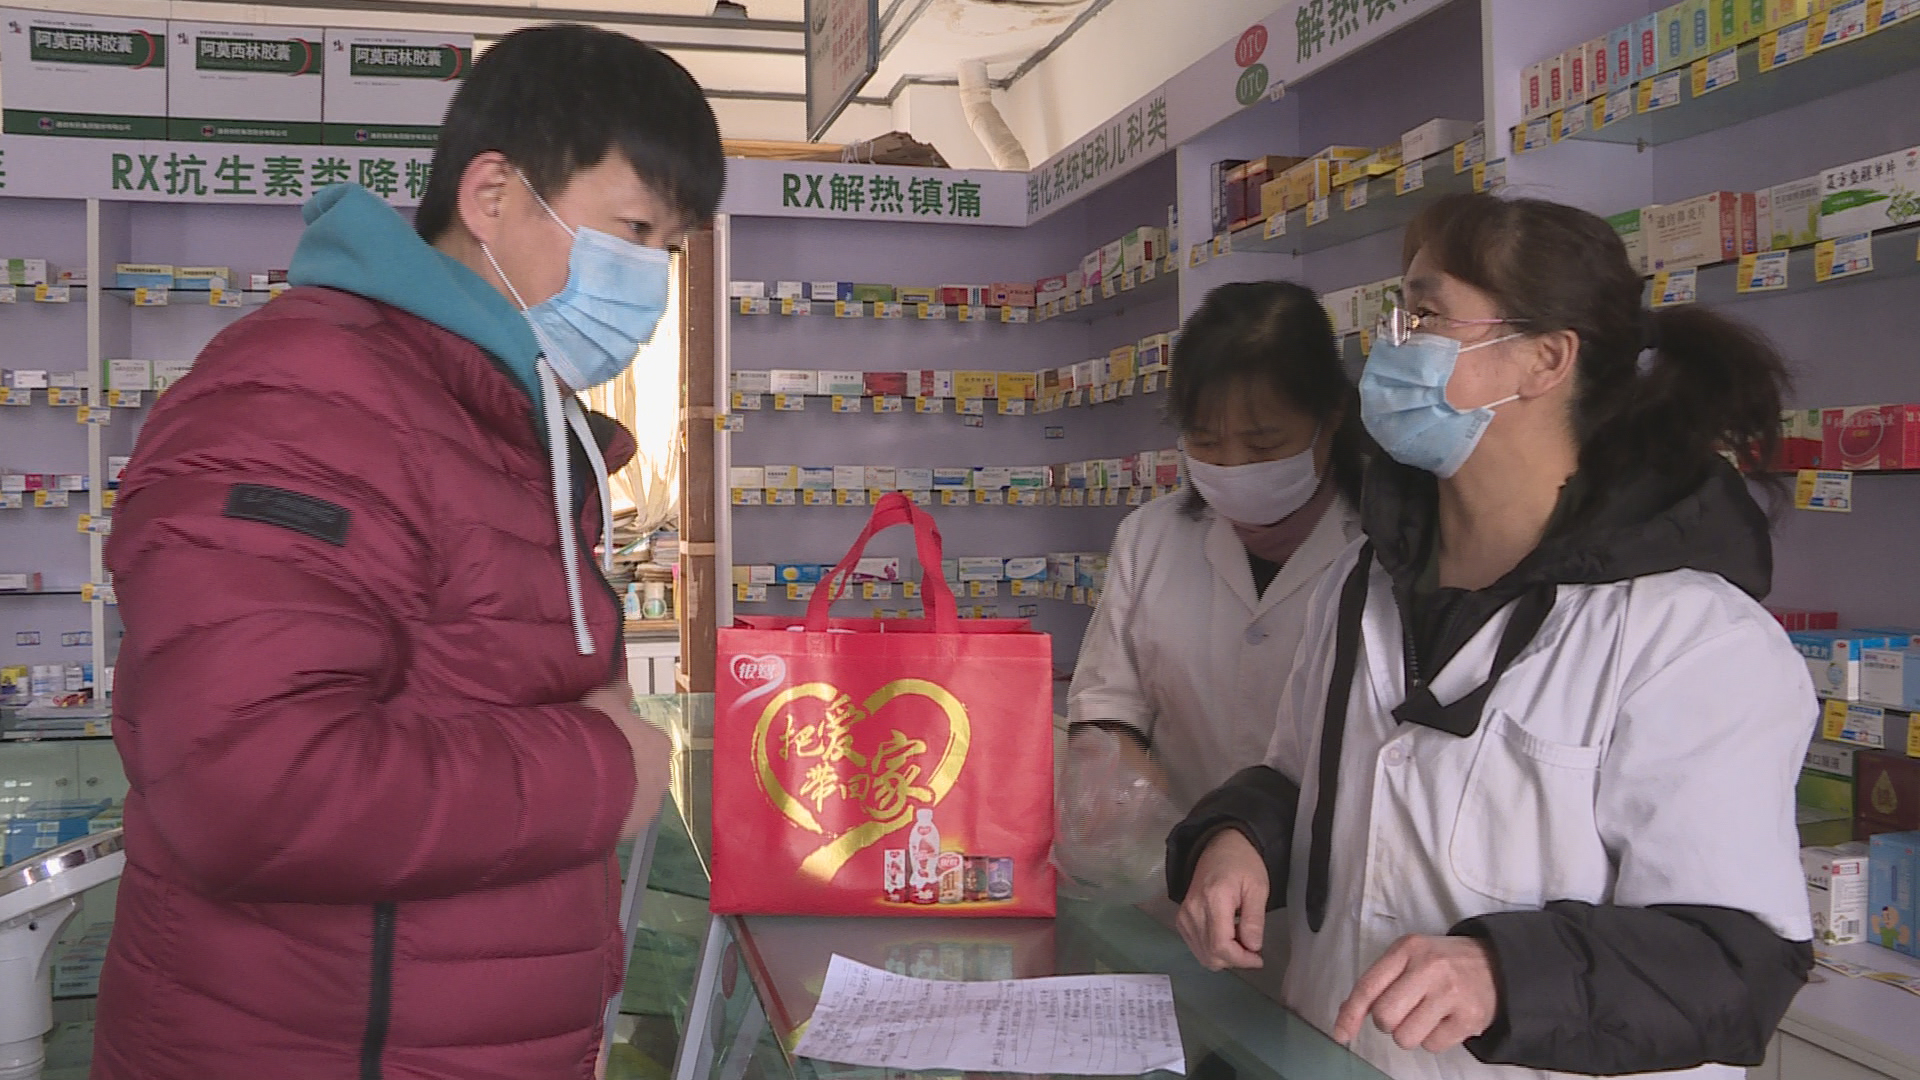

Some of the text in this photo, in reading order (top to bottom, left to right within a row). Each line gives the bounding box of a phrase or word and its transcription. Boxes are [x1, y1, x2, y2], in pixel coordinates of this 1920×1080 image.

[35, 30, 133, 54] 阿莫西林胶囊
[200, 40, 291, 61] 阿莫西林胶囊
[355, 47, 443, 67] 阿莫西林胶囊
[1239, 30, 1262, 62] OTC
[1239, 69, 1262, 100] OTC
[1028, 96, 1167, 214] 消化系统妇科儿科类
[783, 172, 982, 218] RX解热镇痛
